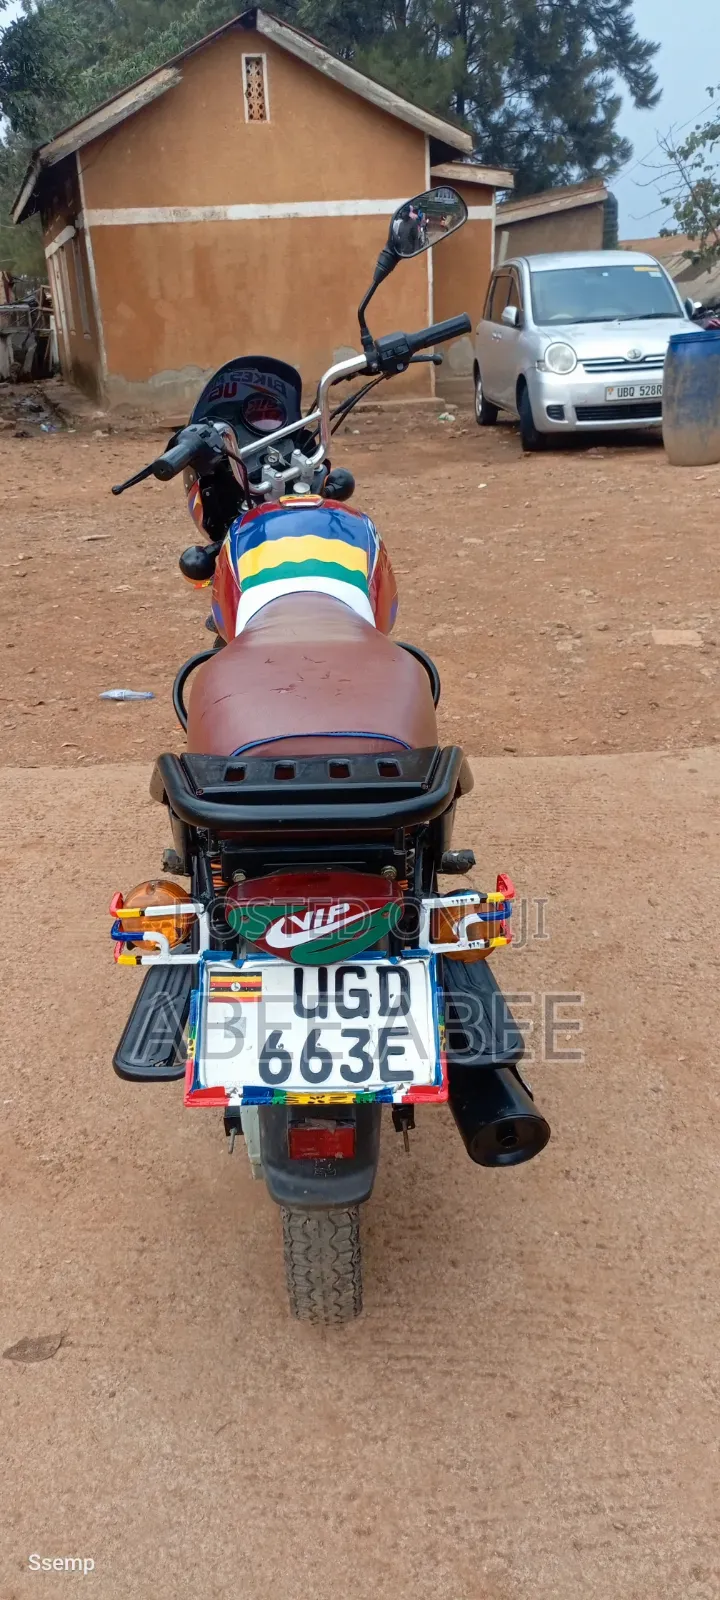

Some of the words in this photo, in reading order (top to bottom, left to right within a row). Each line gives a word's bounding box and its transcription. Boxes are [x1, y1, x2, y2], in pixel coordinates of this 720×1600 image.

[617, 386, 635, 398] UBQ
[640, 384, 663, 396] 528R
[286, 902, 351, 931] VIP
[293, 965, 411, 1019] UGD
[258, 1026, 415, 1084] 663E
